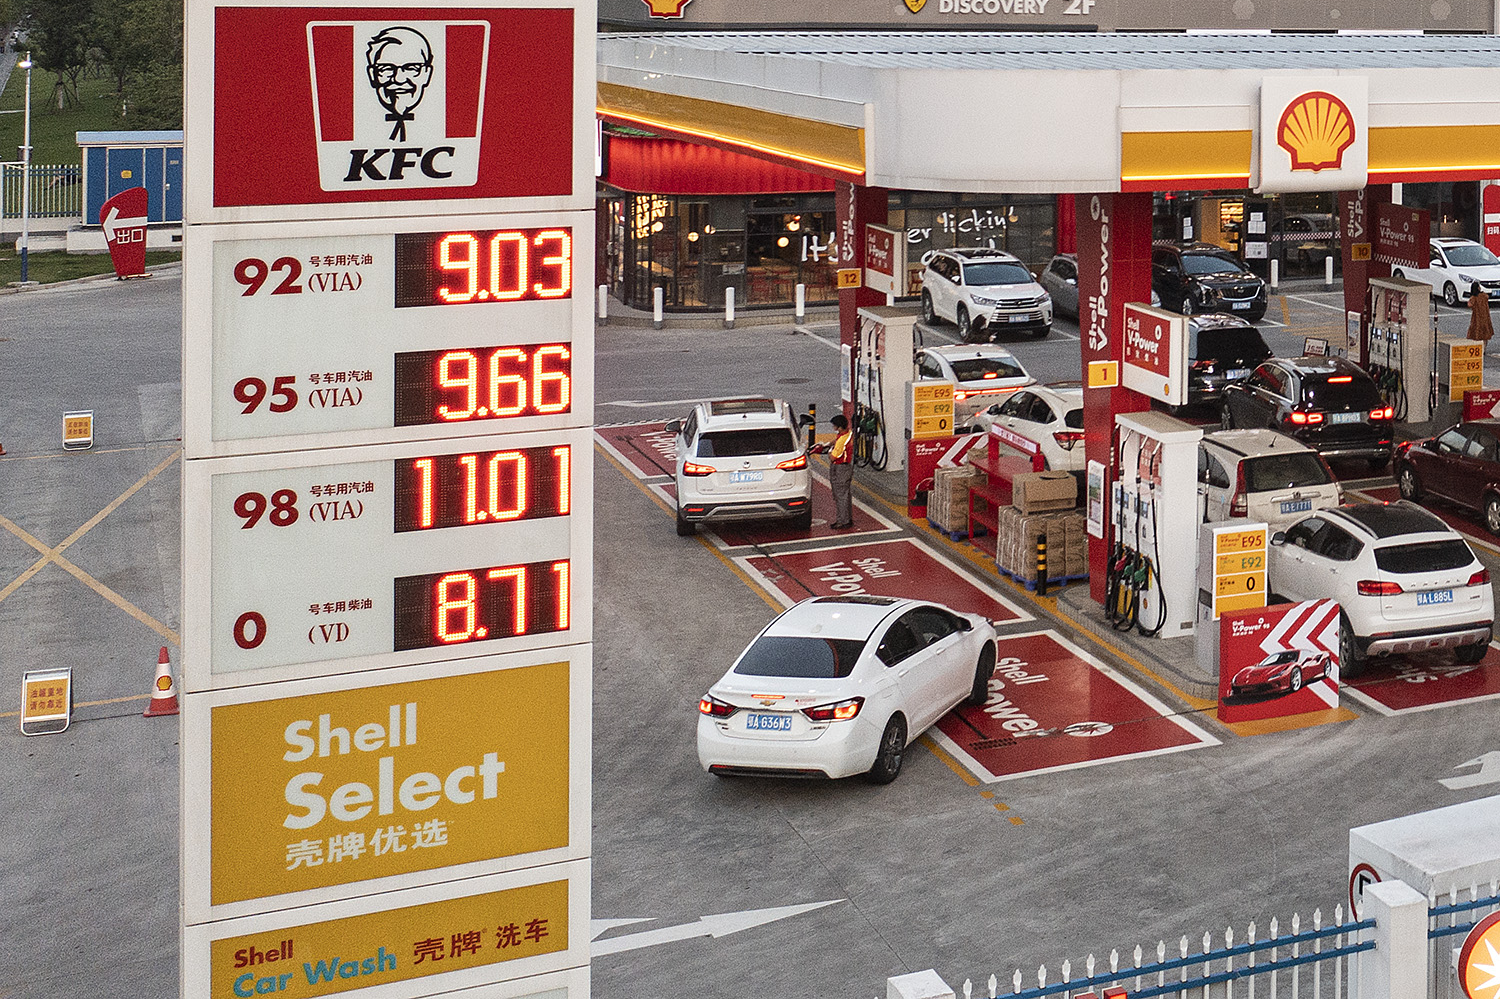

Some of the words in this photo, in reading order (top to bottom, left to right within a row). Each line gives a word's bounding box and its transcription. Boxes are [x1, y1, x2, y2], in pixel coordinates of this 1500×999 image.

[343, 146, 455, 182] KFC
[1354, 189, 1363, 238] V-Po
[117, 229, 143, 244] 出口
[309, 254, 373, 268] 号车用汽油
[1358, 247, 1368, 256] 10
[233, 256, 302, 297] 92
[439, 229, 571, 303] 9.03
[844, 274, 856, 284] 12
[1097, 208, 1109, 351] V-Power
[308, 271, 362, 293] (VIA)
[1089, 296, 1097, 350] Shell
[1127, 329, 1159, 354] V-Power
[309, 370, 373, 384] 号车用汽油
[438, 345, 570, 420] 9.66
[1101, 368, 1107, 380] 1
[233, 375, 299, 415] 95
[308, 386, 362, 409] (VIA)
[934, 388, 950, 398] E95
[939, 419, 947, 430] 0
[309, 481, 374, 497] 号车用汽油
[415, 447, 570, 528] 11.01
[233, 489, 299, 530] 98
[309, 499, 363, 523] (VIA)
[1242, 535, 1262, 548] E95
[852, 557, 902, 578] Shell
[1242, 556, 1262, 569] E92
[1246, 576, 1255, 591] 0
[308, 599, 373, 615] 号车用柴油
[437, 563, 570, 643] 8.71
[233, 611, 267, 650] 0
[996, 657, 1049, 685] Shell
[283, 702, 418, 762] Shell
[282, 752, 505, 830] Select
[285, 818, 448, 871] 壳牌优选
[234, 939, 294, 969] Shell
[413, 930, 484, 965] 壳牌
[495, 918, 550, 950] 洗车
[233, 970, 293, 998] Car
[303, 946, 397, 986] Wash
